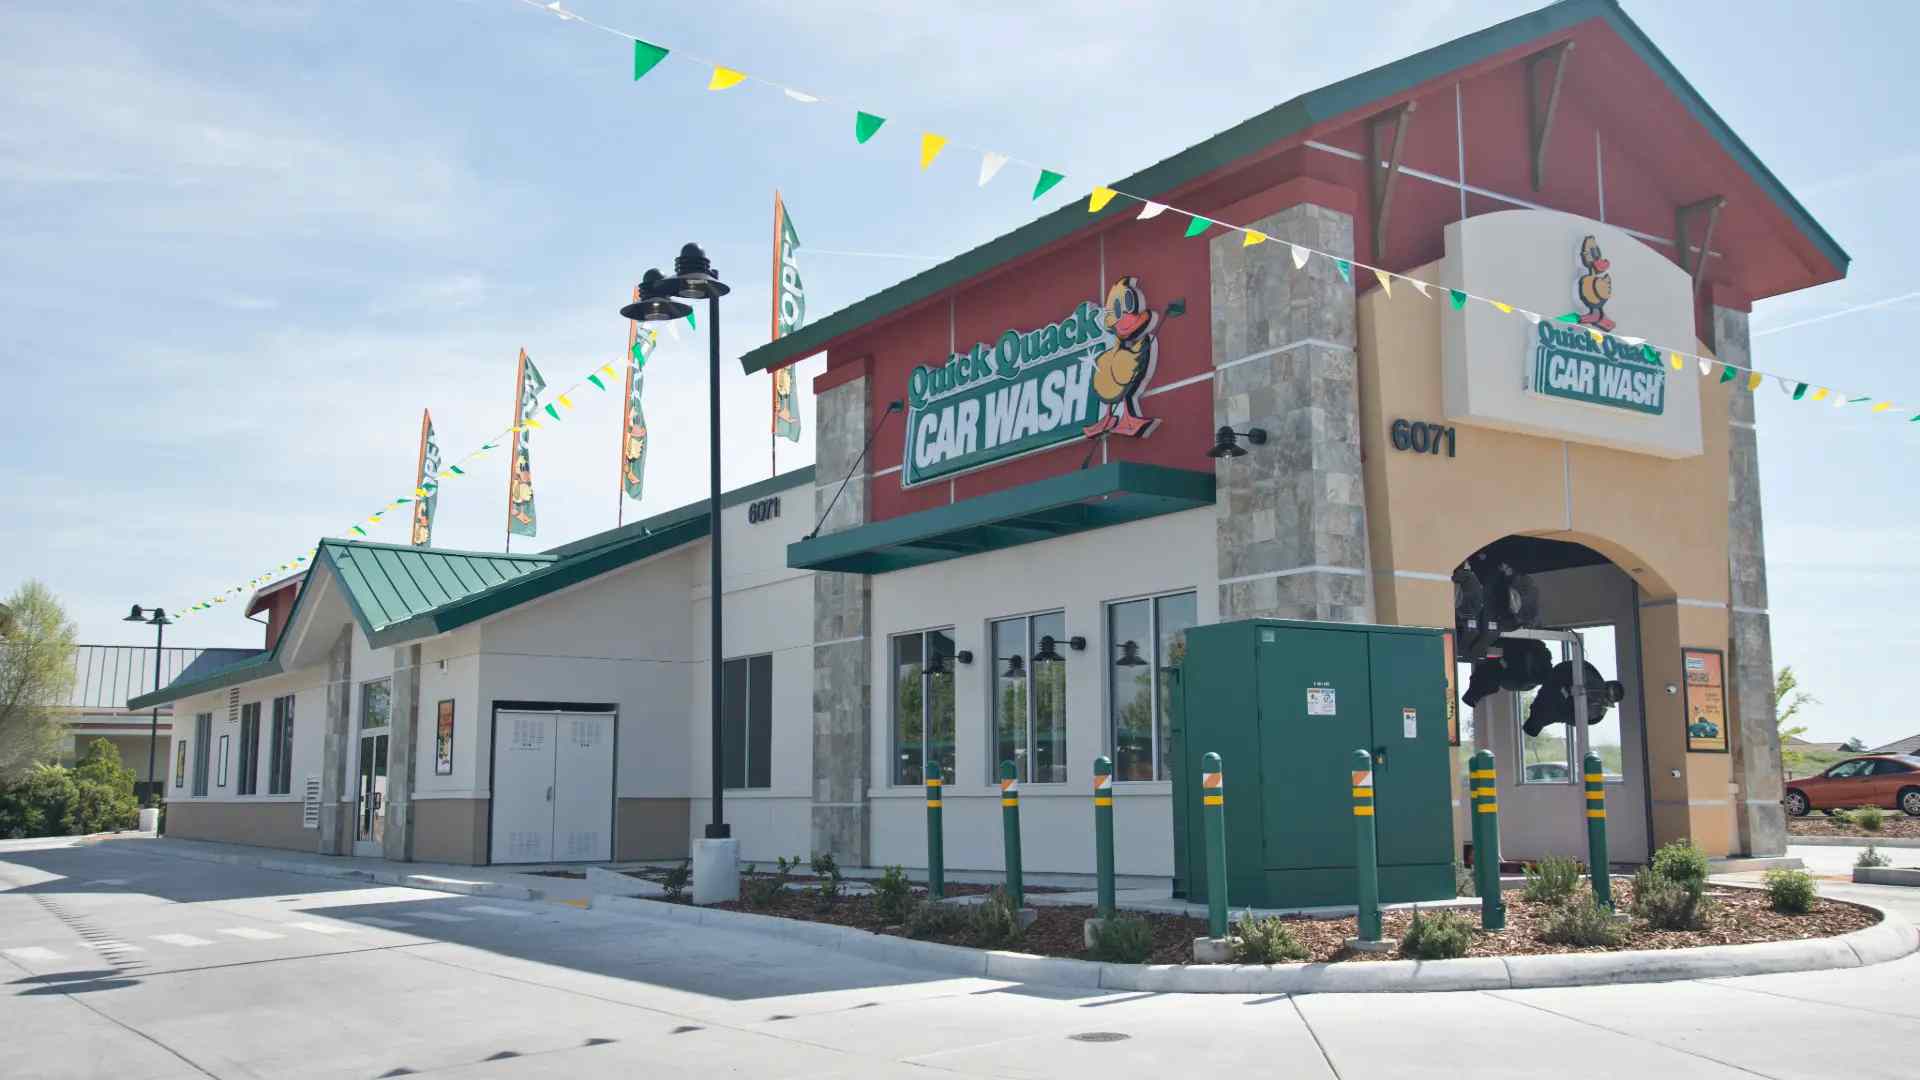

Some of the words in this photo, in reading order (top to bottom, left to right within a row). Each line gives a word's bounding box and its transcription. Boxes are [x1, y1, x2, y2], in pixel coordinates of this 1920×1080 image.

[909, 343, 993, 410] Quick
[995, 302, 1102, 378] Quack
[1538, 320, 1601, 353] Quick
[1549, 355, 1596, 395] CAR
[1599, 364, 1664, 407] WASH
[915, 399, 981, 469] CAR
[983, 361, 1094, 449] WASH
[1391, 419, 1456, 457] 6071
[748, 496, 781, 524] 6071
